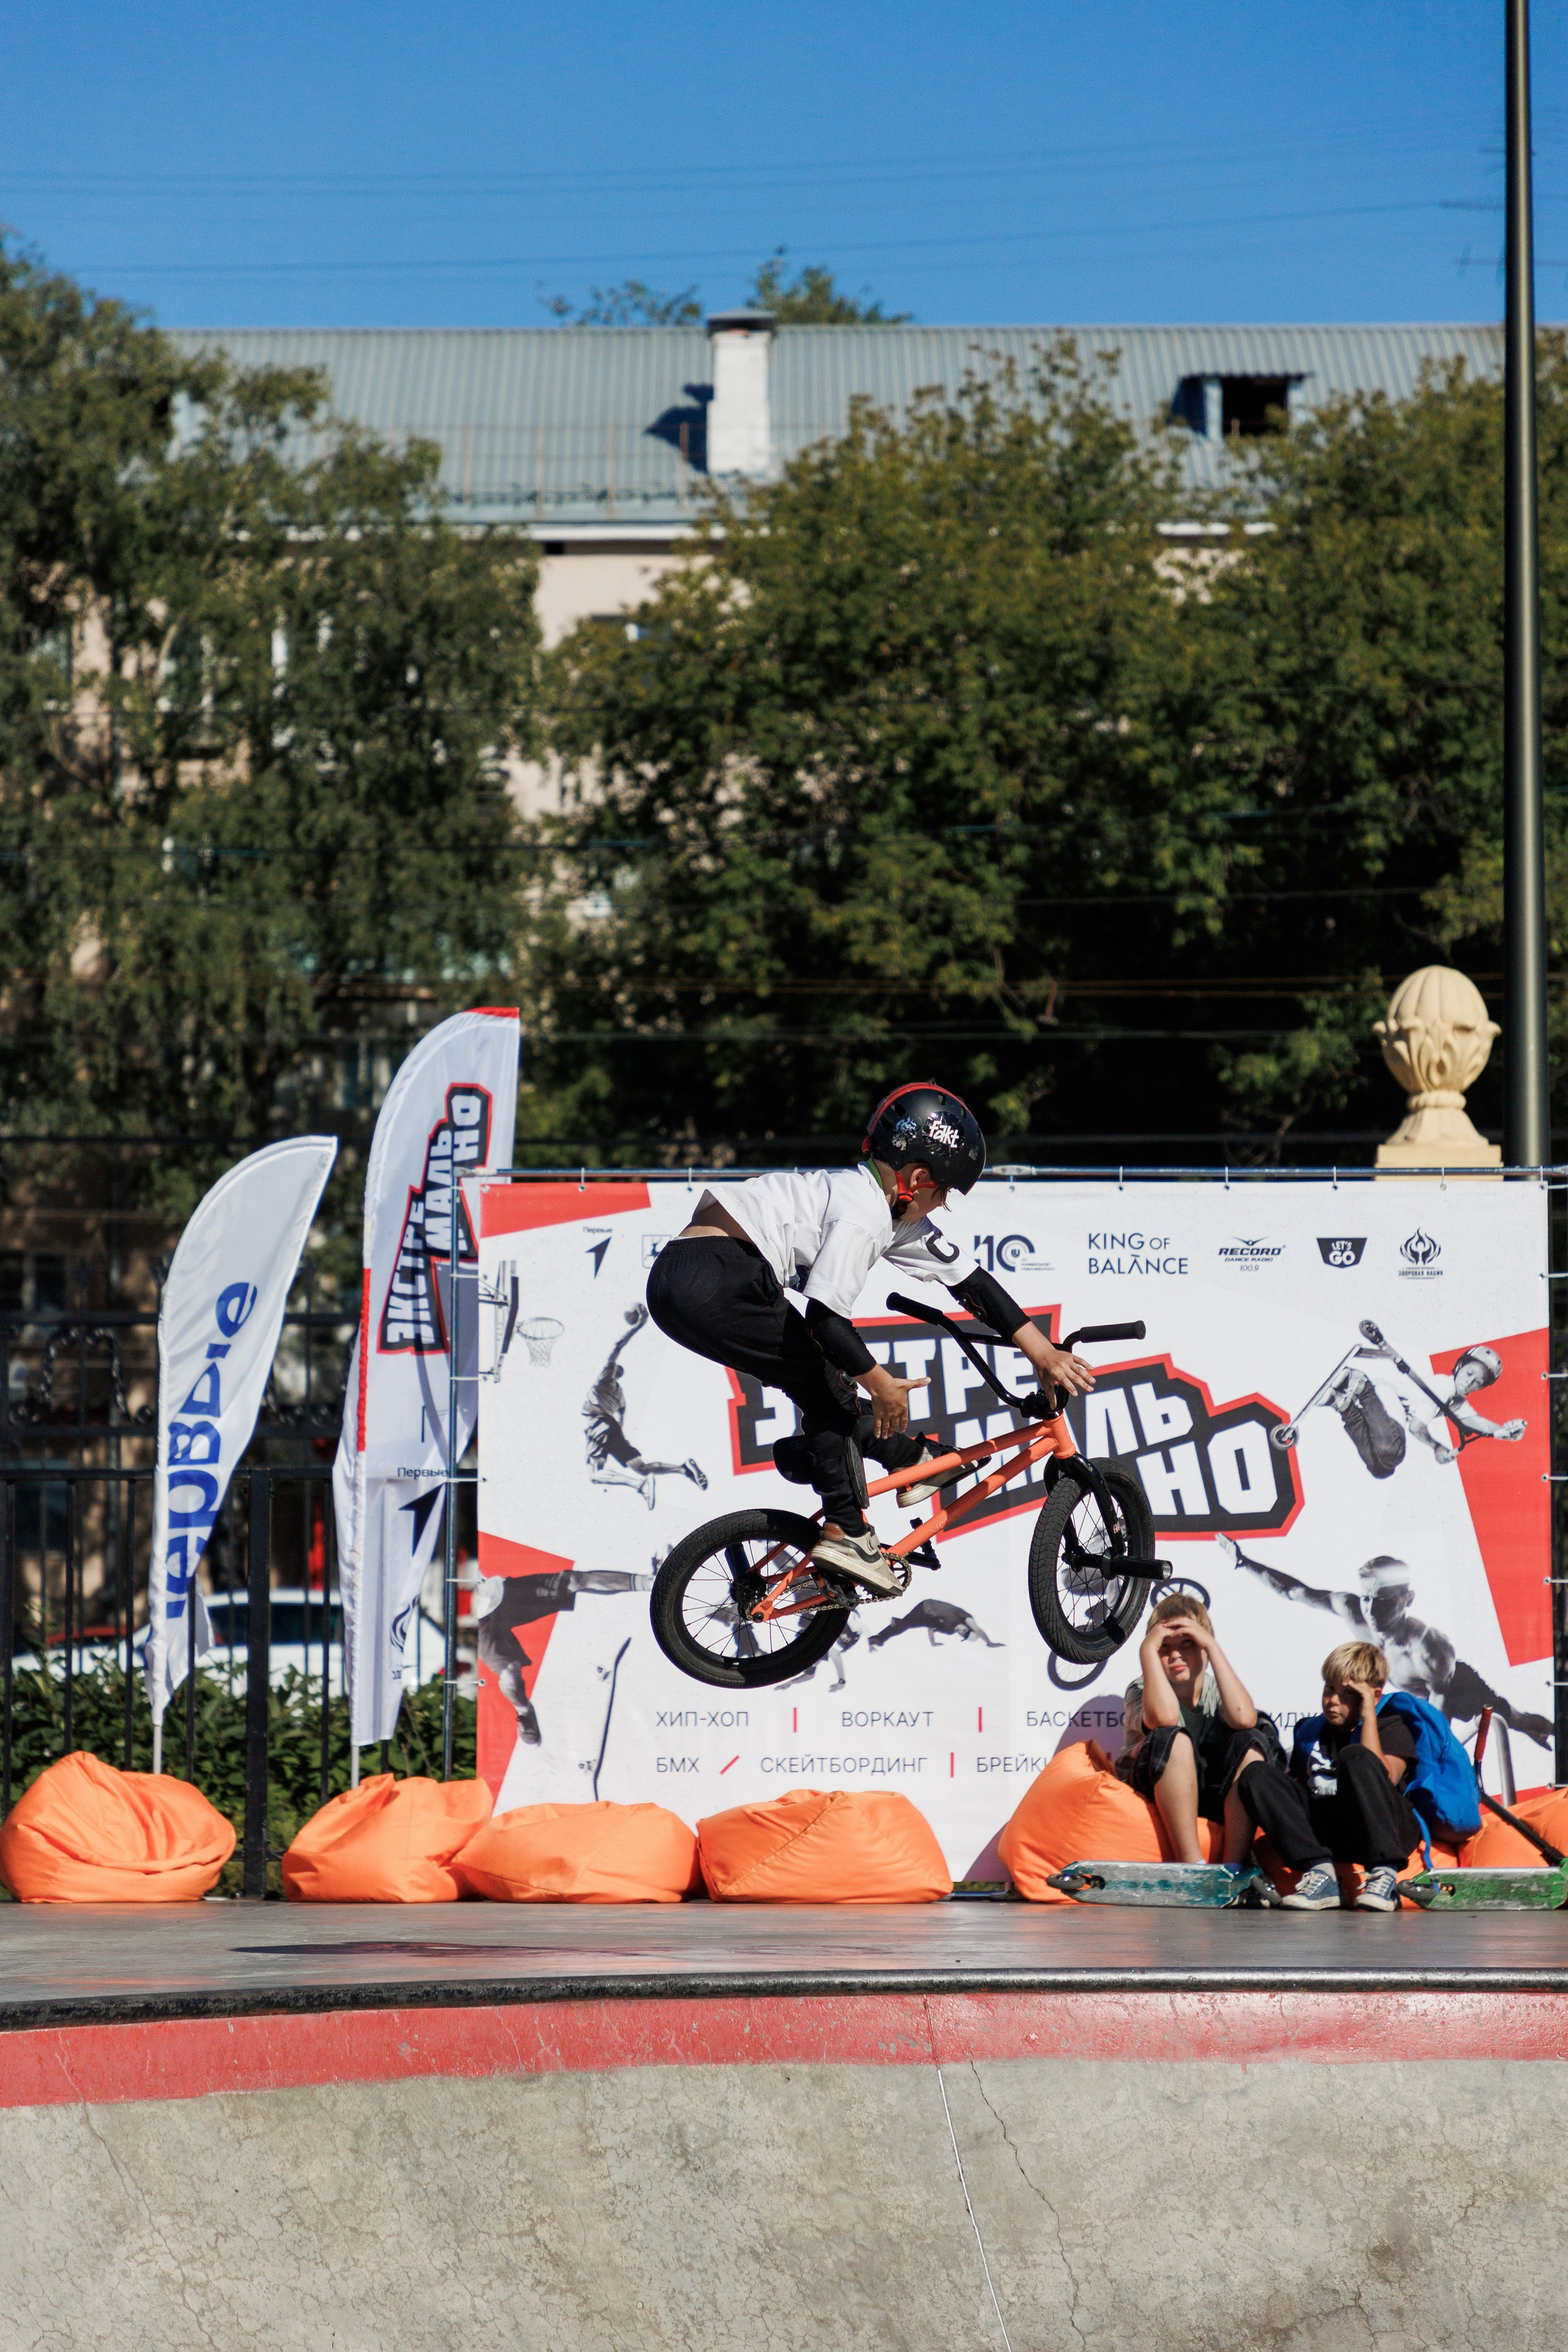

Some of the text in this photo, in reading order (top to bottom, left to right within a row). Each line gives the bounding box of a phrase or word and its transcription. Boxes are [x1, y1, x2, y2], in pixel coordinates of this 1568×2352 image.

[451, 1095, 481, 1162] НО
[1088, 1232, 1170, 1250] KING OF
[1331, 1241, 1352, 1251] LET'S
[1329, 1250, 1355, 1265] GO
[386, 1200, 435, 1343] ЭКСТРЕ
[1136, 1420, 1278, 1516] НО
[655, 1711, 749, 1727] ХИП-ХОП
[842, 1711, 934, 1727] ВОРКАУТ
[761, 1753, 927, 1774] СКЕЙТБОРДИНГ
